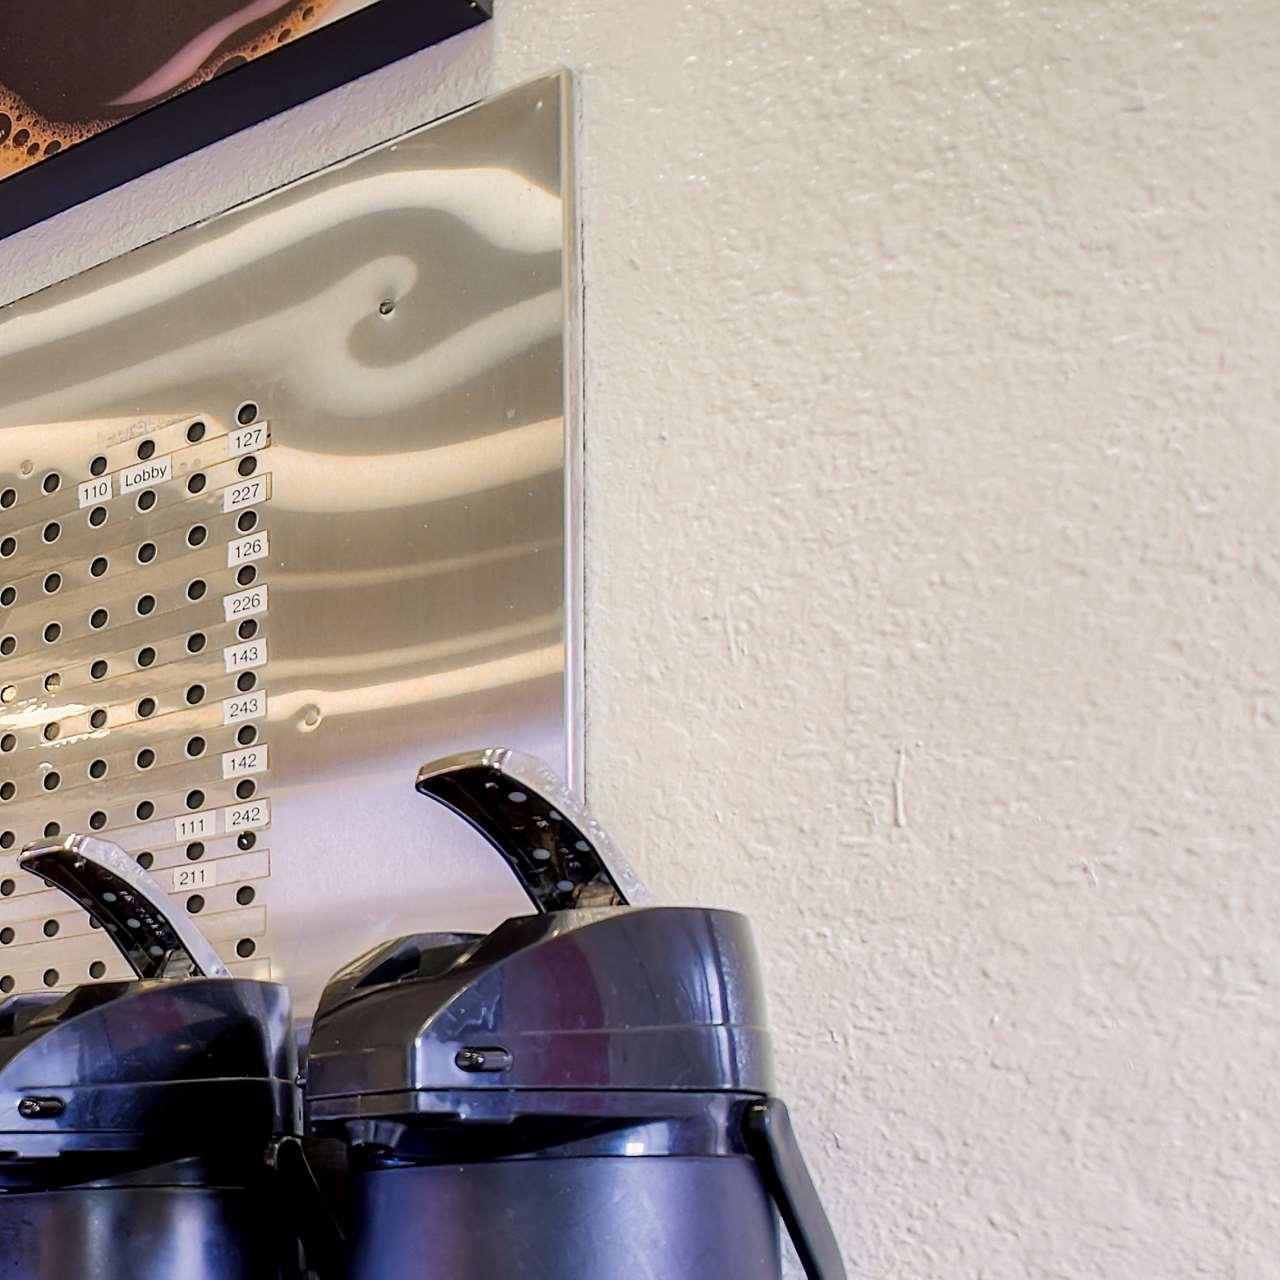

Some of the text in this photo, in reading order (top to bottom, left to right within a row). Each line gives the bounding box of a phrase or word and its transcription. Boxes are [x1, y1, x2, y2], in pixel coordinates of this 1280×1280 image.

[234, 427, 264, 449] 127
[83, 463, 168, 501] 110 Lobby
[232, 483, 260, 503] 227
[234, 538, 262, 559] 126
[232, 594, 261, 615] 226
[231, 646, 259, 667] 143
[229, 699, 258, 718] 243
[229, 753, 257, 771] 142
[181, 817, 206, 835] 111
[232, 807, 261, 825] 242
[179, 868, 206, 886] 211
